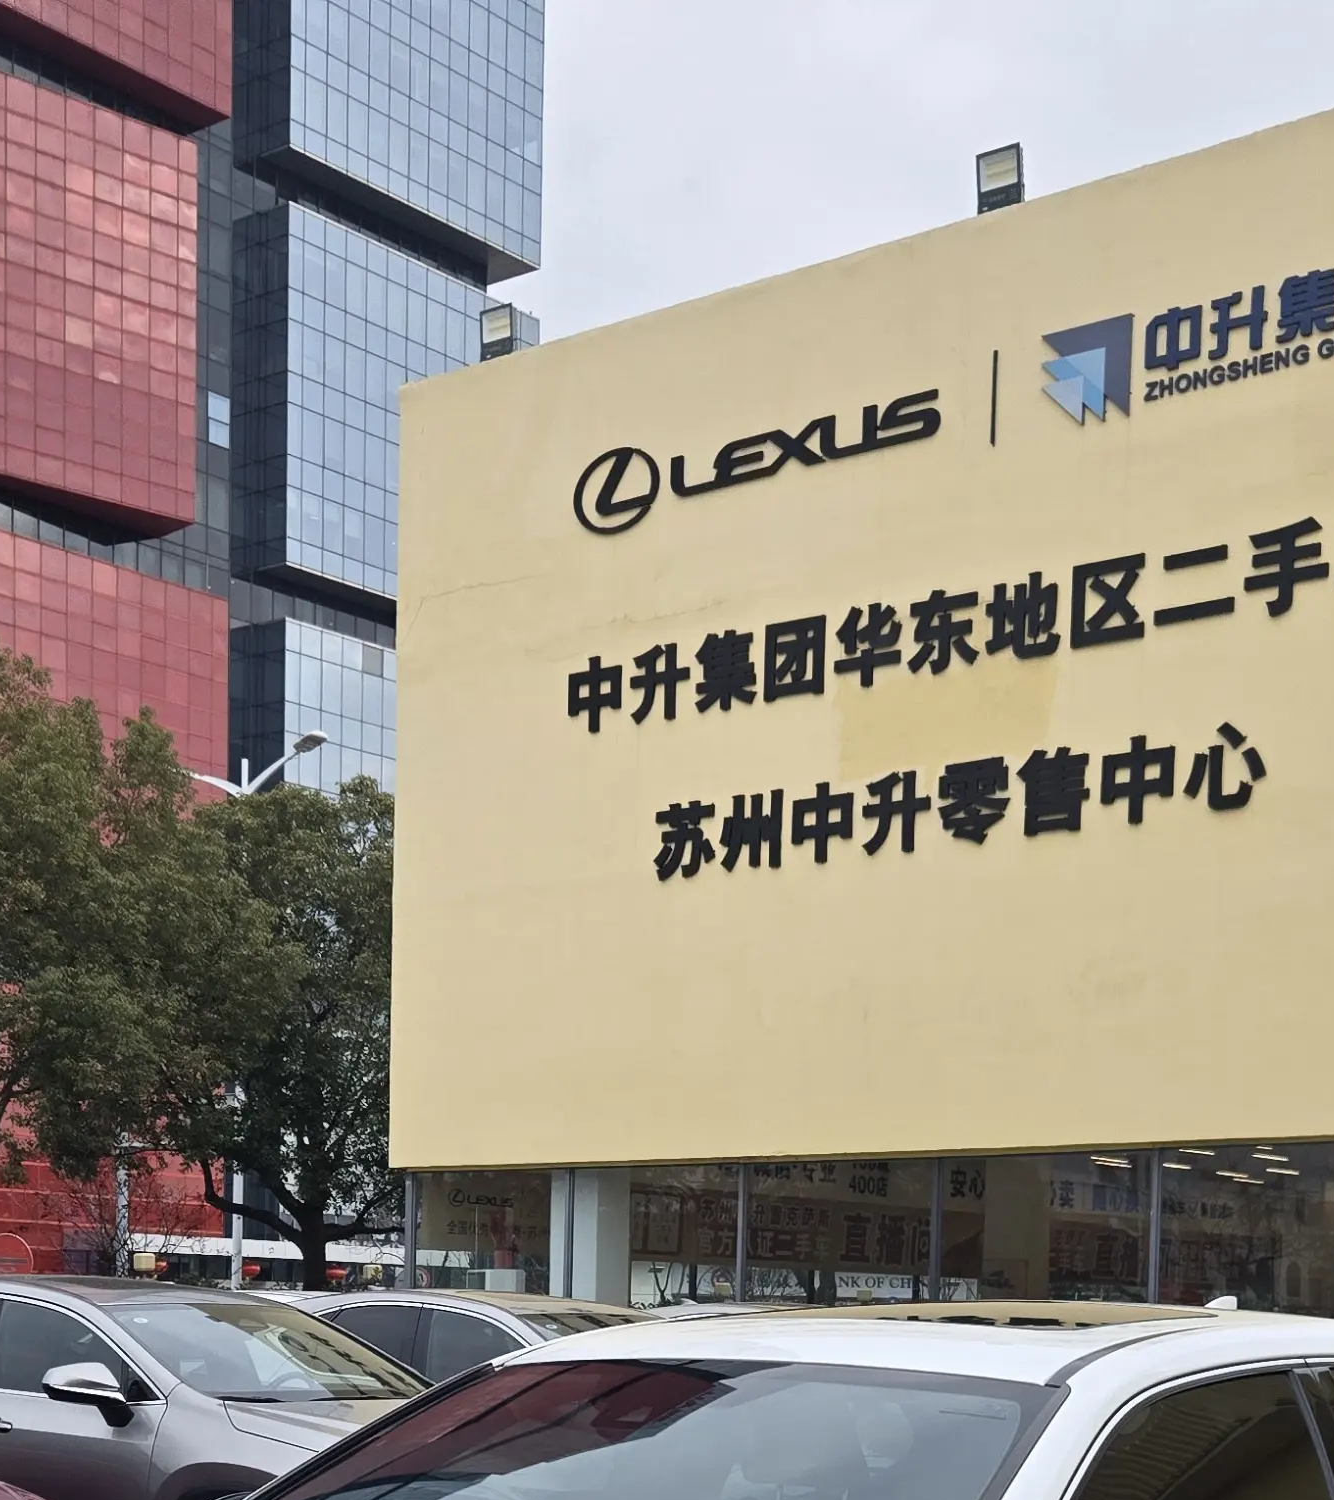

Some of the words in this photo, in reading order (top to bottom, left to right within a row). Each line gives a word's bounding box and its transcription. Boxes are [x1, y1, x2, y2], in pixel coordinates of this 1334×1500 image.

[1143, 342, 1311, 402] ZHONGSHENG
[669, 388, 941, 497] LEXUS
[653, 721, 1269, 883] 苏州中升零售中心
[466, 1194, 514, 1209] LEXUS
